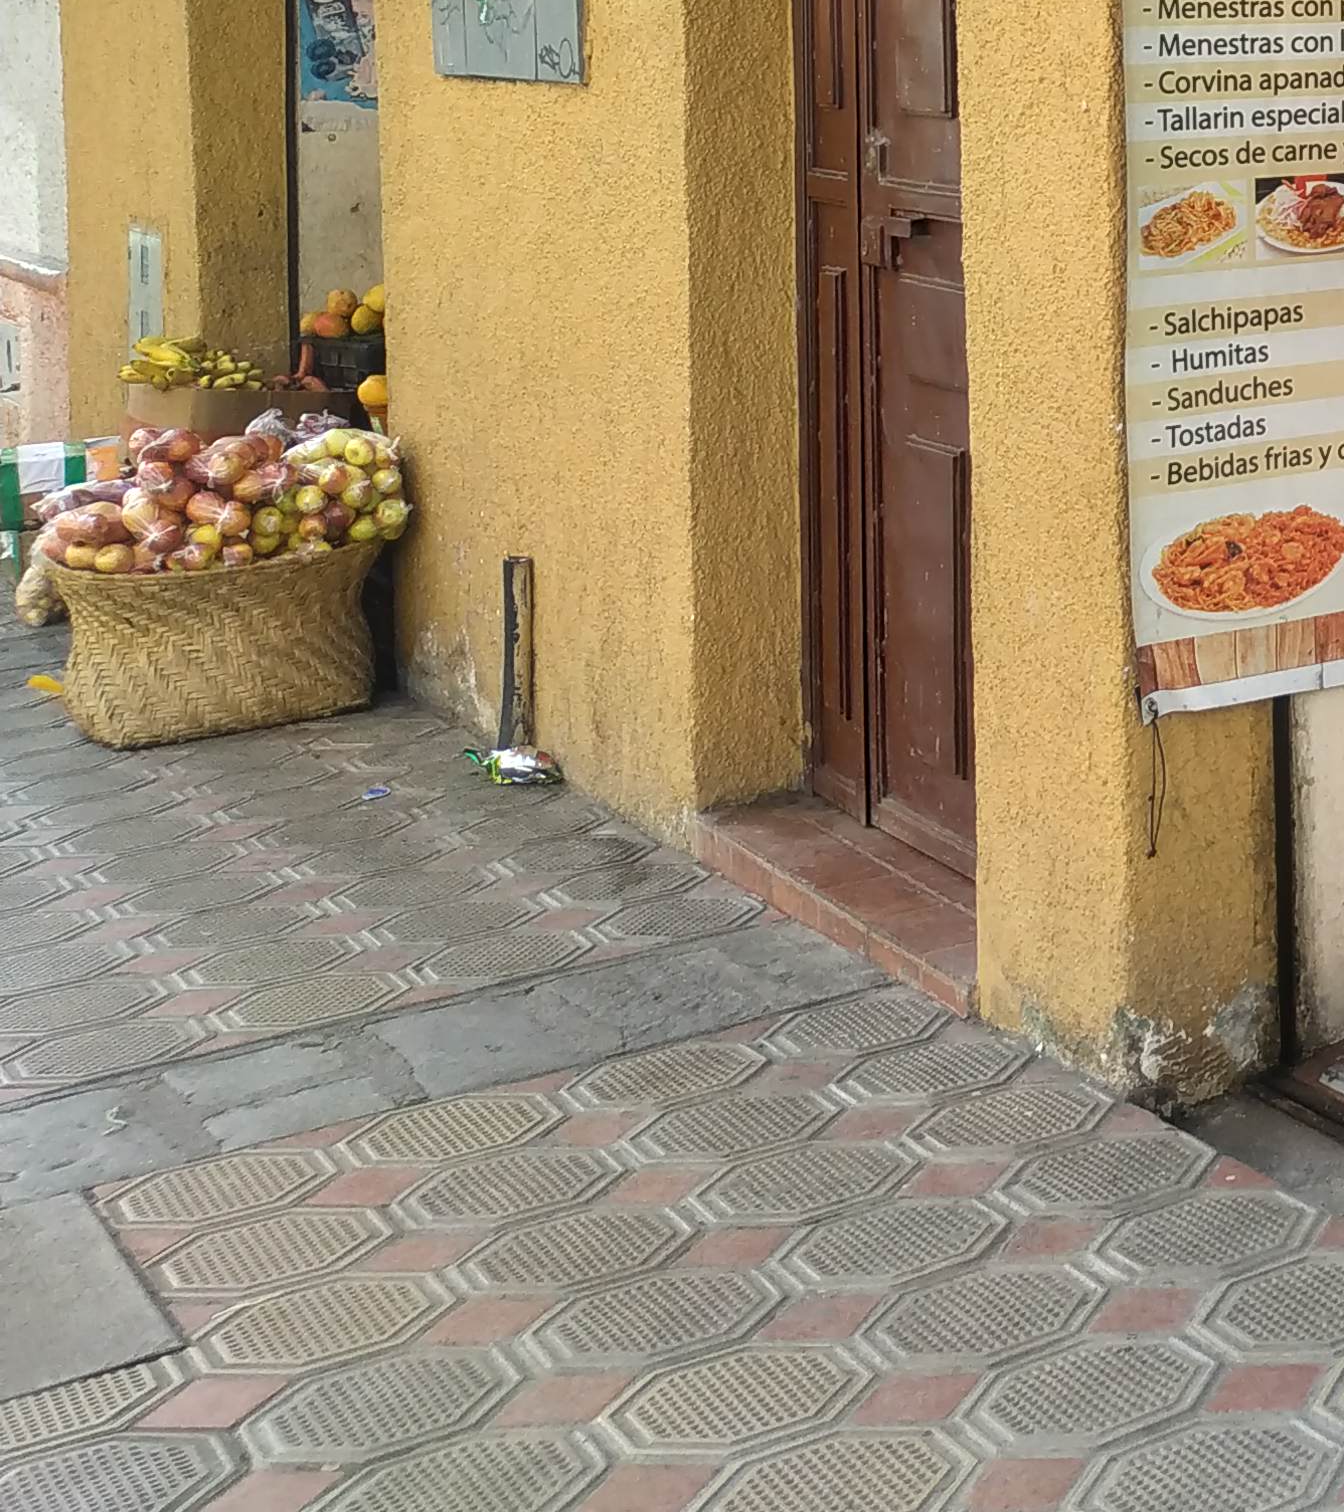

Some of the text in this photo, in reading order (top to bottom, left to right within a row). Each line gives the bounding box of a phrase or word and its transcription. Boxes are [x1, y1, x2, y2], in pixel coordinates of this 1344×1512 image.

[1292, 0, 1333, 17] con
[1158, 34, 1284, 56] Menestras
[1292, 35, 1333, 54] con
[1159, 68, 1252, 93] Corvina
[1158, 106, 1244, 131] Tallarin
[1160, 144, 1229, 169] Secos
[1236, 141, 1265, 164] de
[1272, 139, 1338, 161] carne
[1164, 301, 1304, 337] Salchipapas
[1172, 342, 1269, 374] Humitas
[1167, 376, 1294, 412] Sanduches
[1166, 415, 1267, 448] Tostadas
[1167, 453, 1259, 486] Bebidas
[1264, 446, 1313, 472] frias
[1318, 448, 1332, 469] y
